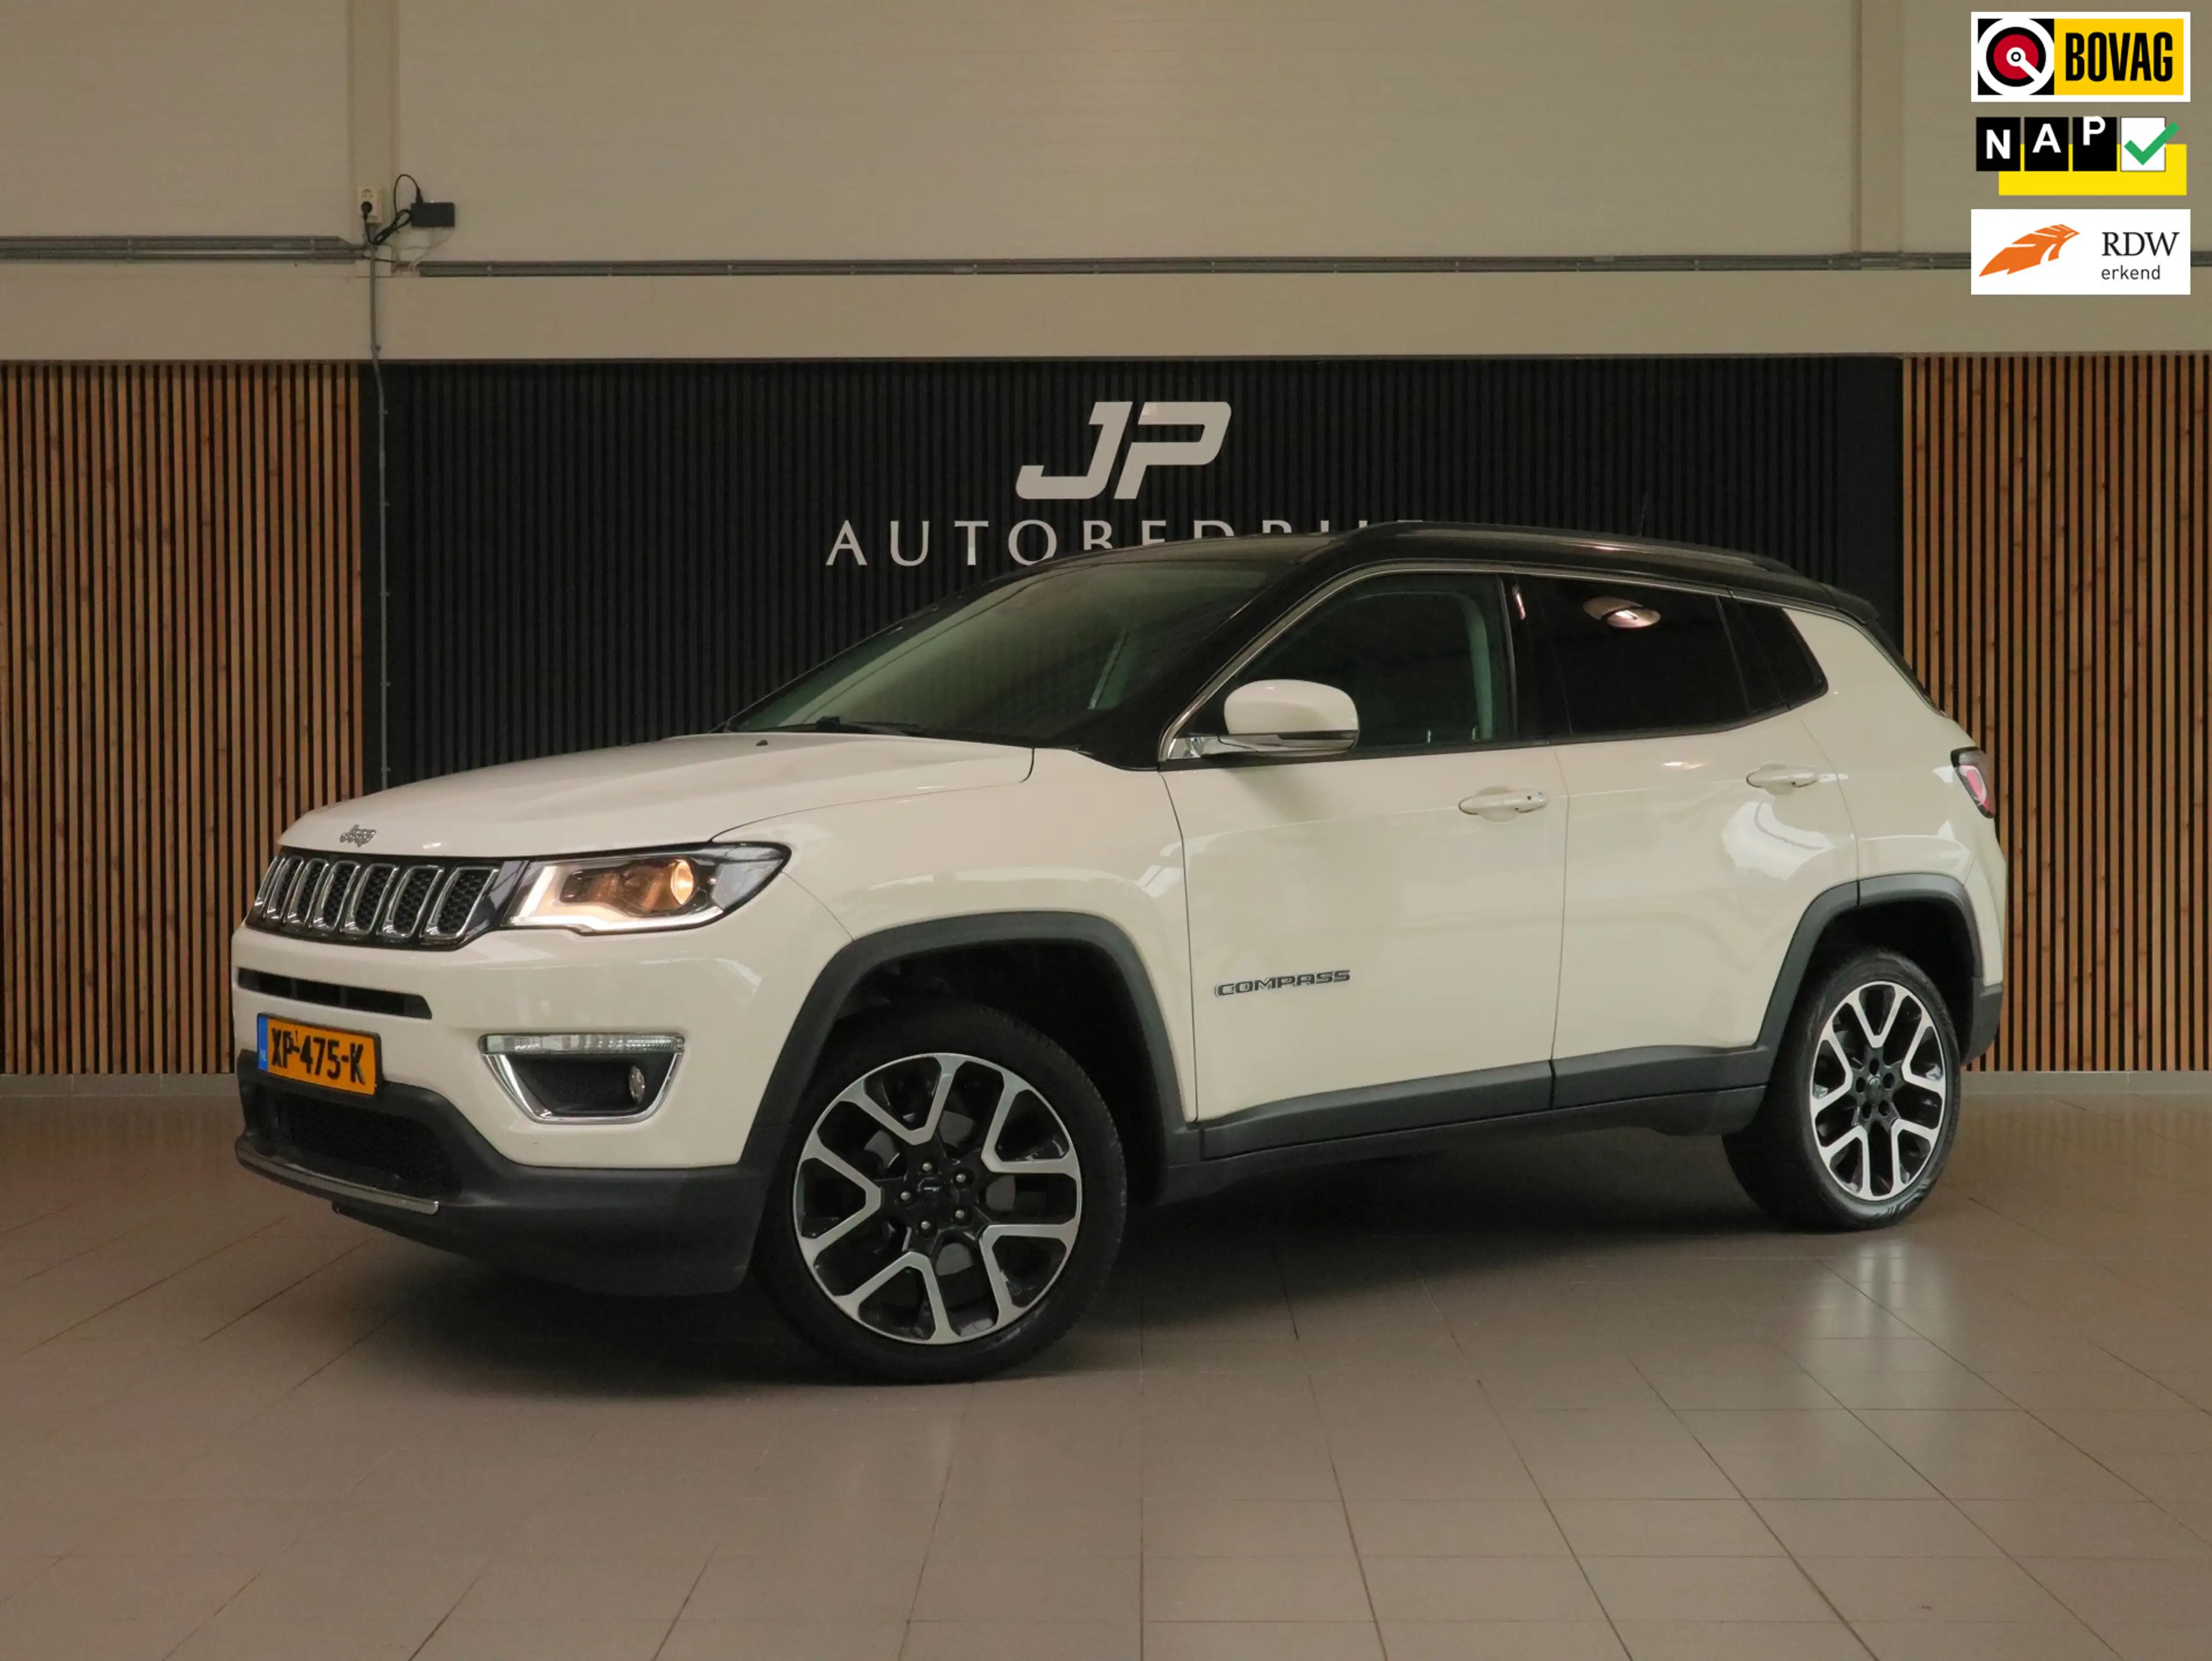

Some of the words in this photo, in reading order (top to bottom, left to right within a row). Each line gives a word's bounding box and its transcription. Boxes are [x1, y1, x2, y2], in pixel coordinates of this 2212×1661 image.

[1016, 401, 1231, 499] JP
[1215, 969, 1350, 997] COMPASS
[271, 1028, 366, 1085] XP-475-K
